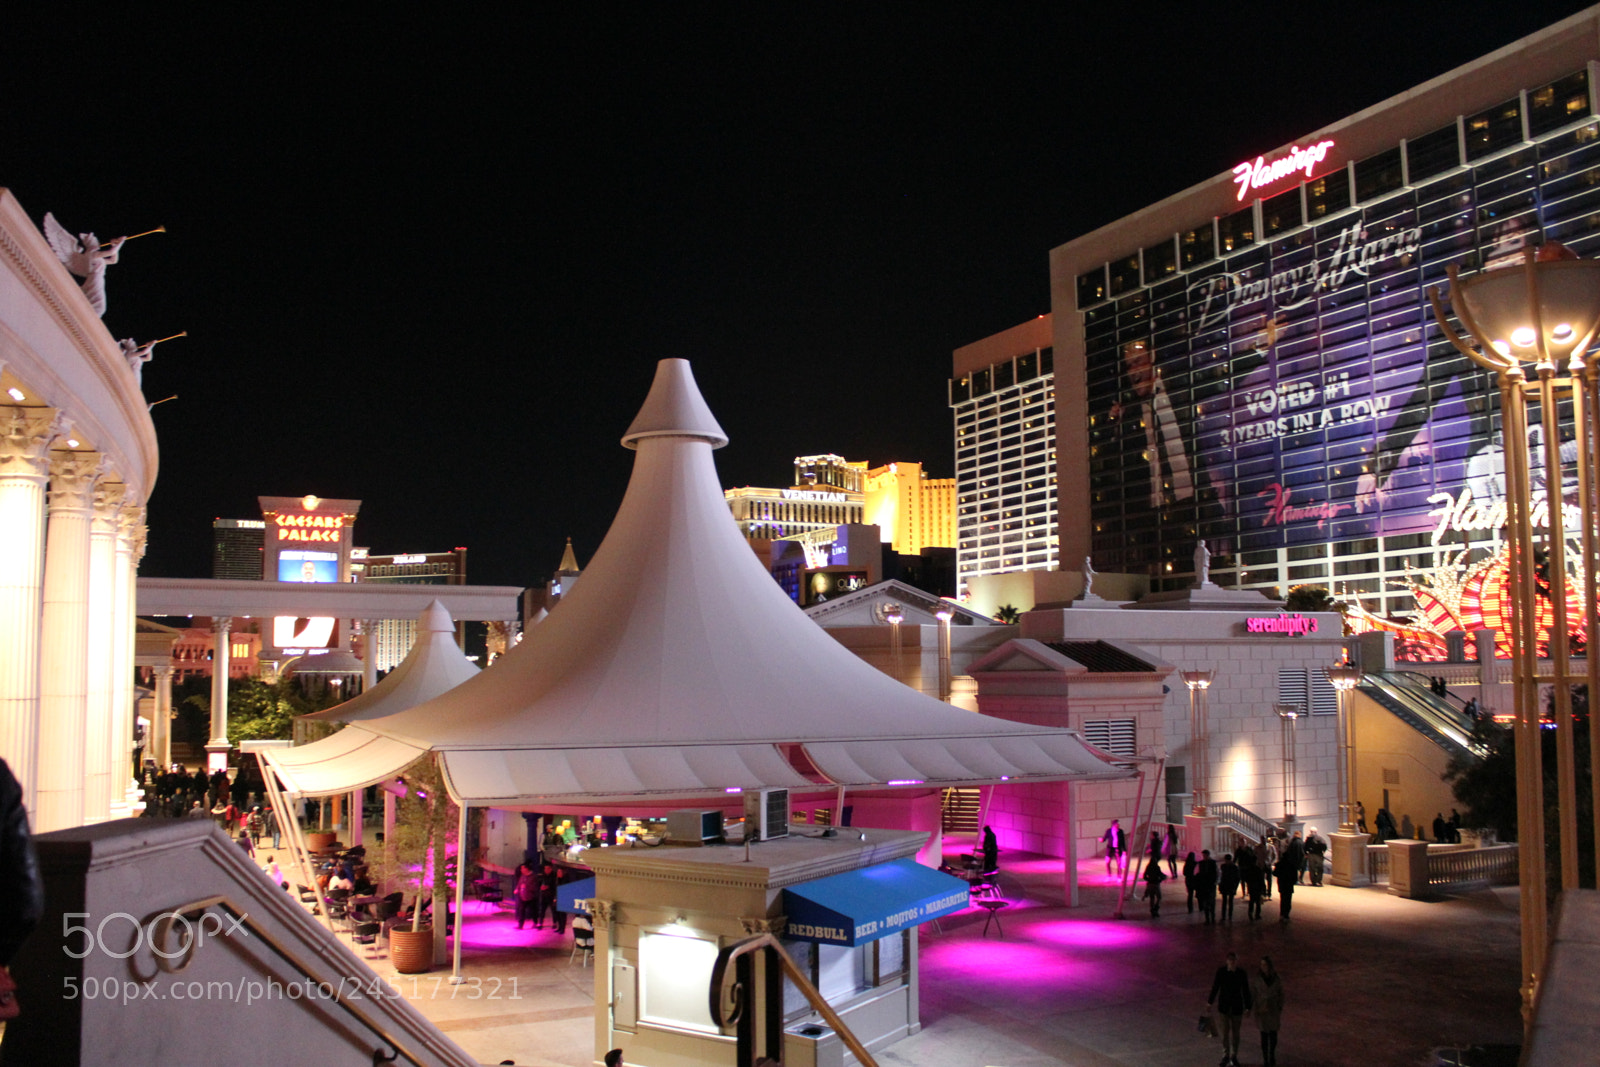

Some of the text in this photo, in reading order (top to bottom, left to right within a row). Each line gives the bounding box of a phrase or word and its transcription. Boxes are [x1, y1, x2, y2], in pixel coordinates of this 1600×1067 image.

[1232, 140, 1335, 201] Flamingo
[1245, 372, 1350, 416] VOTED #1
[1220, 395, 1392, 448] 3 YEARS IN A ROW
[782, 489, 847, 502] VENETIAN
[236, 520, 265, 529] TRUM
[275, 514, 344, 530] CAESARS
[278, 529, 340, 543] PALACE
[1247, 613, 1319, 636] serendipity 3
[855, 890, 969, 939] BEER MOJITOS MARGARITAS
[788, 923, 848, 941] REDBULL
